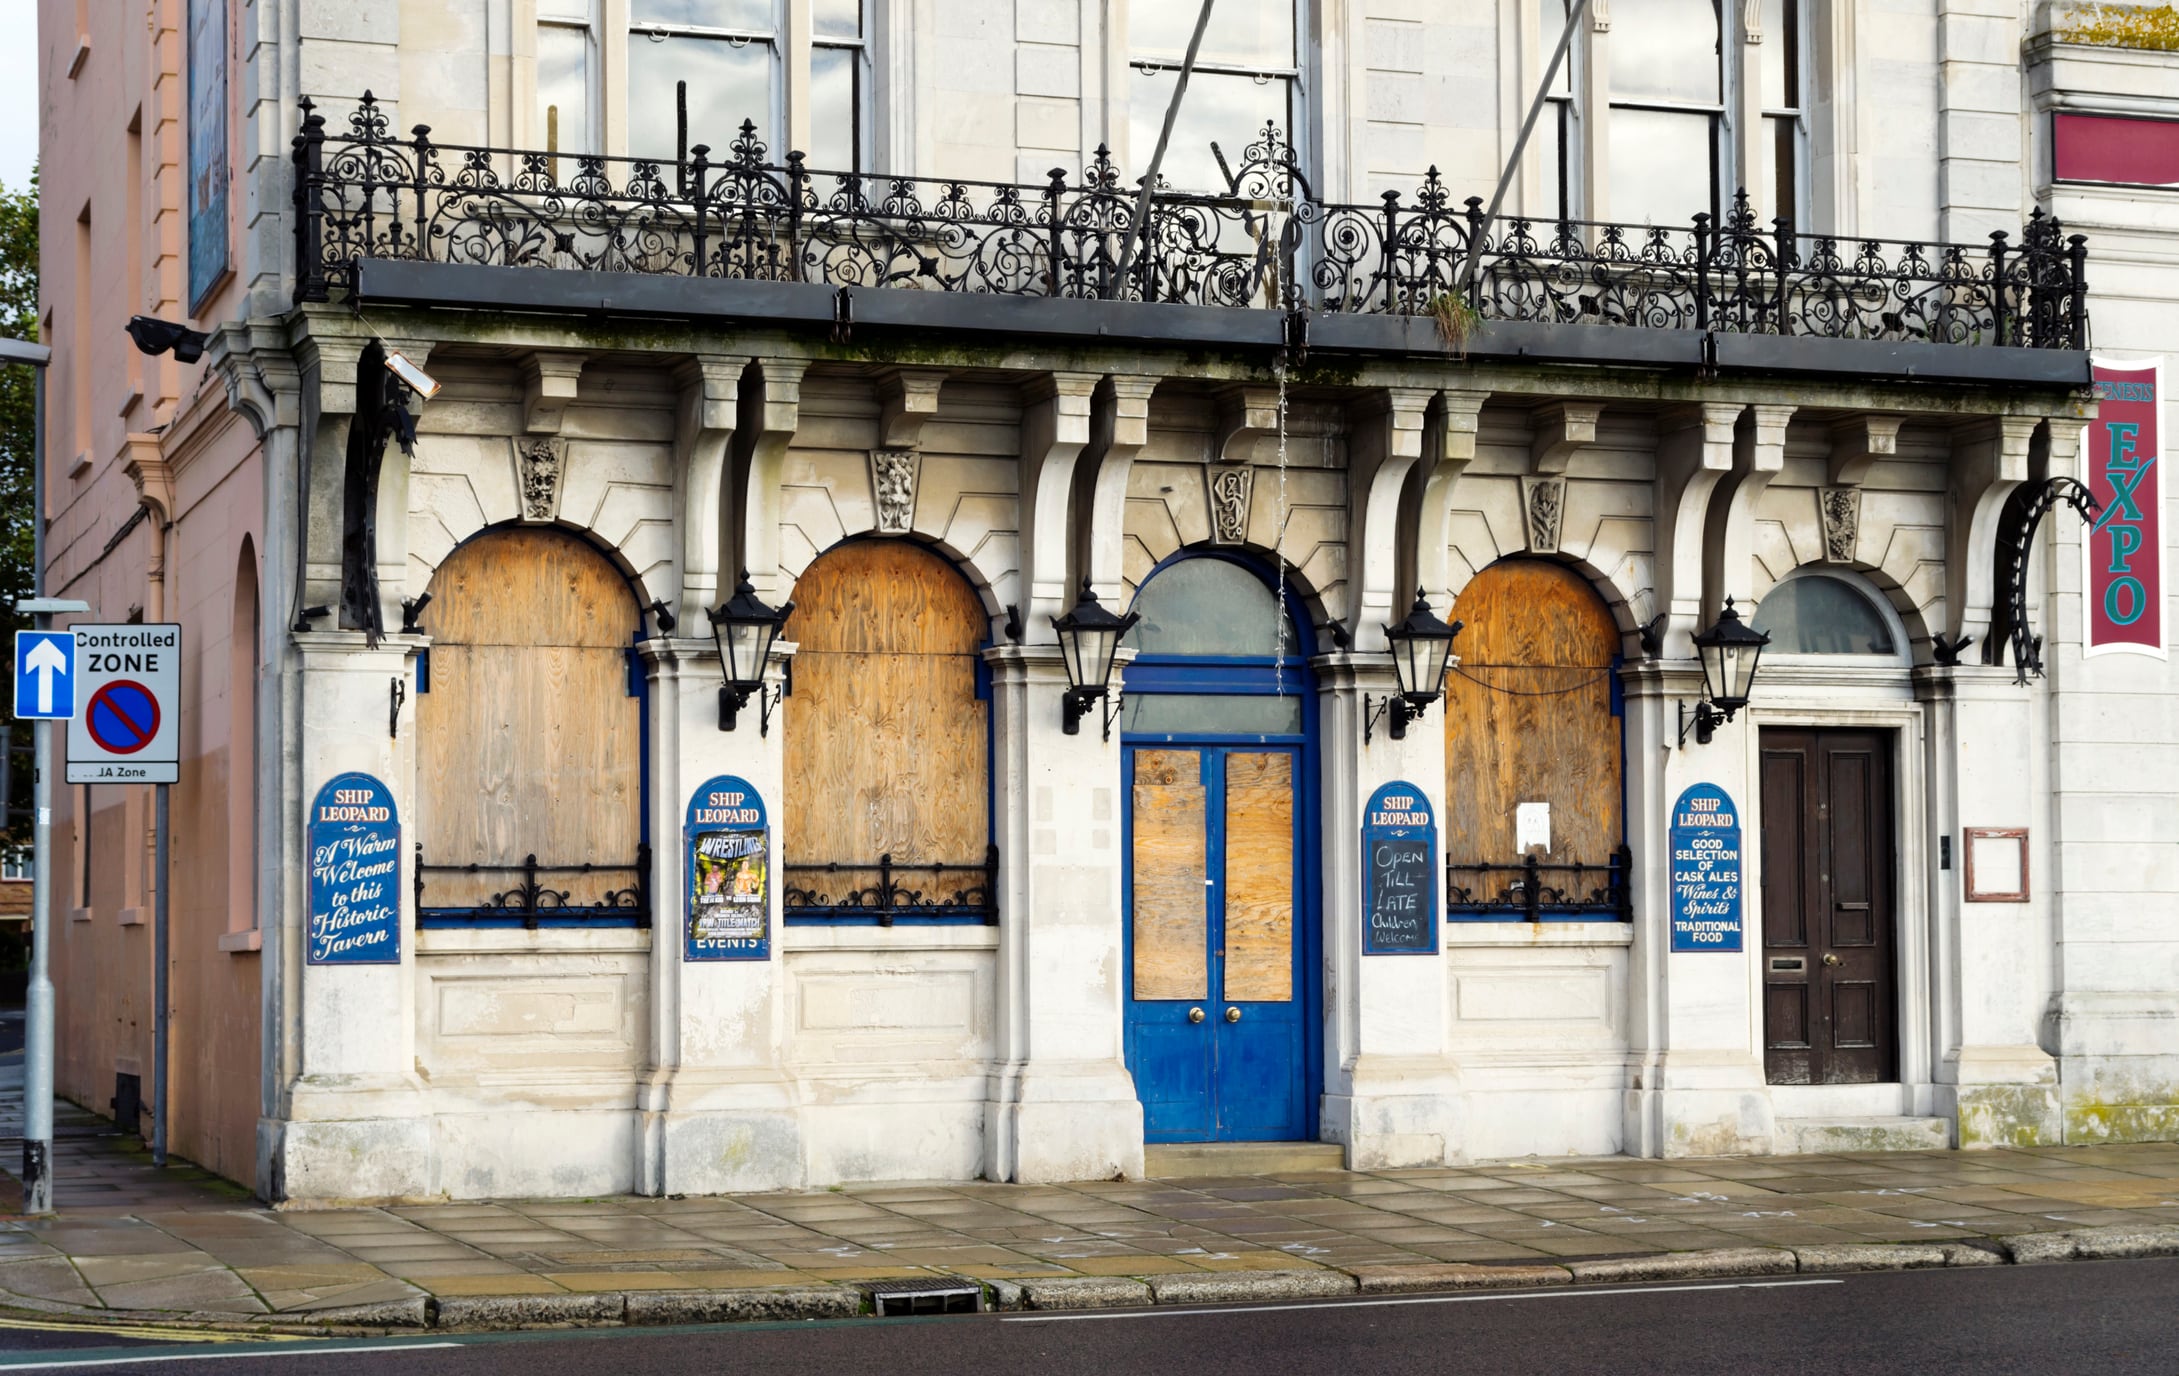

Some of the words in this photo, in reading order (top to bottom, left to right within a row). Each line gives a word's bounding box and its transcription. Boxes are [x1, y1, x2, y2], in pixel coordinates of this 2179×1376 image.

[2094, 381, 2154, 402] ENESIS
[2091, 422, 2156, 625] EXPO
[77, 632, 175, 647] Controlled
[88, 654, 159, 672] ZONE
[99, 767, 113, 777] JA
[117, 767, 146, 777] Zone
[334, 789, 374, 804] SHIP
[709, 792, 745, 807] SHIP
[1383, 796, 1414, 810] SHIP
[1690, 798, 1721, 812] SHIP
[320, 806, 390, 822] LEOPARD
[696, 809, 760, 824] LEOPARD
[1372, 812, 1428, 826] LEOPARD
[1679, 813, 1733, 827] LEOPARD
[313, 840, 340, 867] A
[341, 832, 396, 858] Warm
[700, 836, 763, 859] WRESTLING
[1691, 839, 1723, 850] GOOD
[1675, 850, 1738, 861] SELECTION
[313, 860, 395, 887] Welcome
[1698, 861, 1713, 871] OF
[1675, 872, 1706, 882] CASK
[1708, 872, 1738, 882] ALES
[331, 891, 348, 908] to
[350, 881, 383, 904] this
[1676, 884, 1720, 900] Wines
[1722, 885, 1737, 900] &
[1683, 900, 1730, 919] Spirits
[312, 905, 395, 938] Historic
[1371, 913, 1418, 929] Children
[1675, 921, 1741, 932] TRADITIONAL
[313, 929, 389, 961] Tavern
[696, 938, 758, 949] EVENTS
[1692, 932, 1723, 943] FOOD
